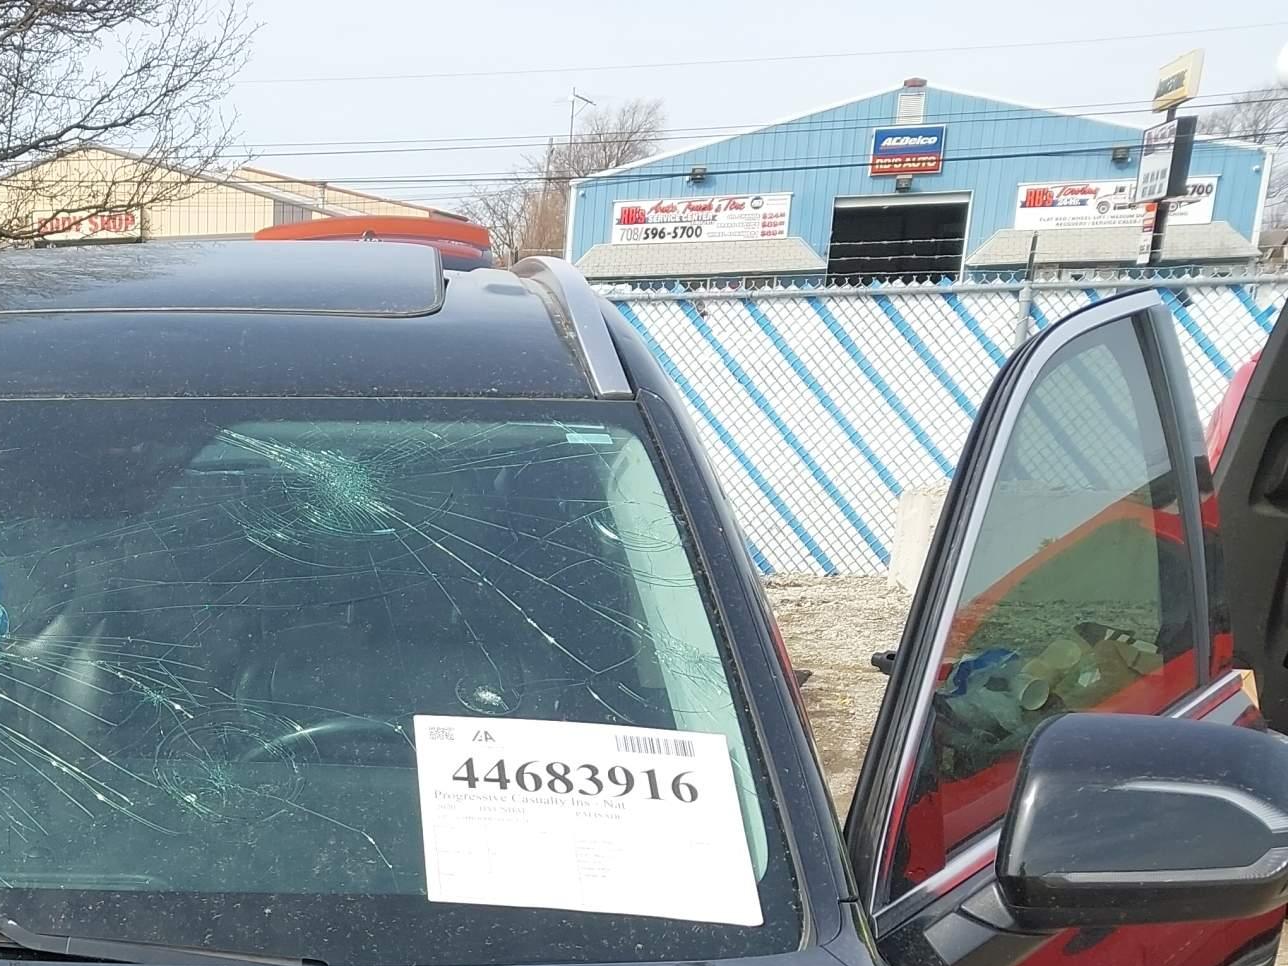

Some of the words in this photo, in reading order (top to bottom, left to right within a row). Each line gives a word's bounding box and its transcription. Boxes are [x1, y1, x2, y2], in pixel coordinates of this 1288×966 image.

[880, 135, 938, 146] ACDelco
[647, 214, 680, 223] SERVICE
[452, 757, 699, 803] 44683916
[434, 789, 507, 803] Progressive
[512, 794, 567, 808] Casualty
[571, 797, 591, 807] Ins
[603, 799, 626, 809] Nat
